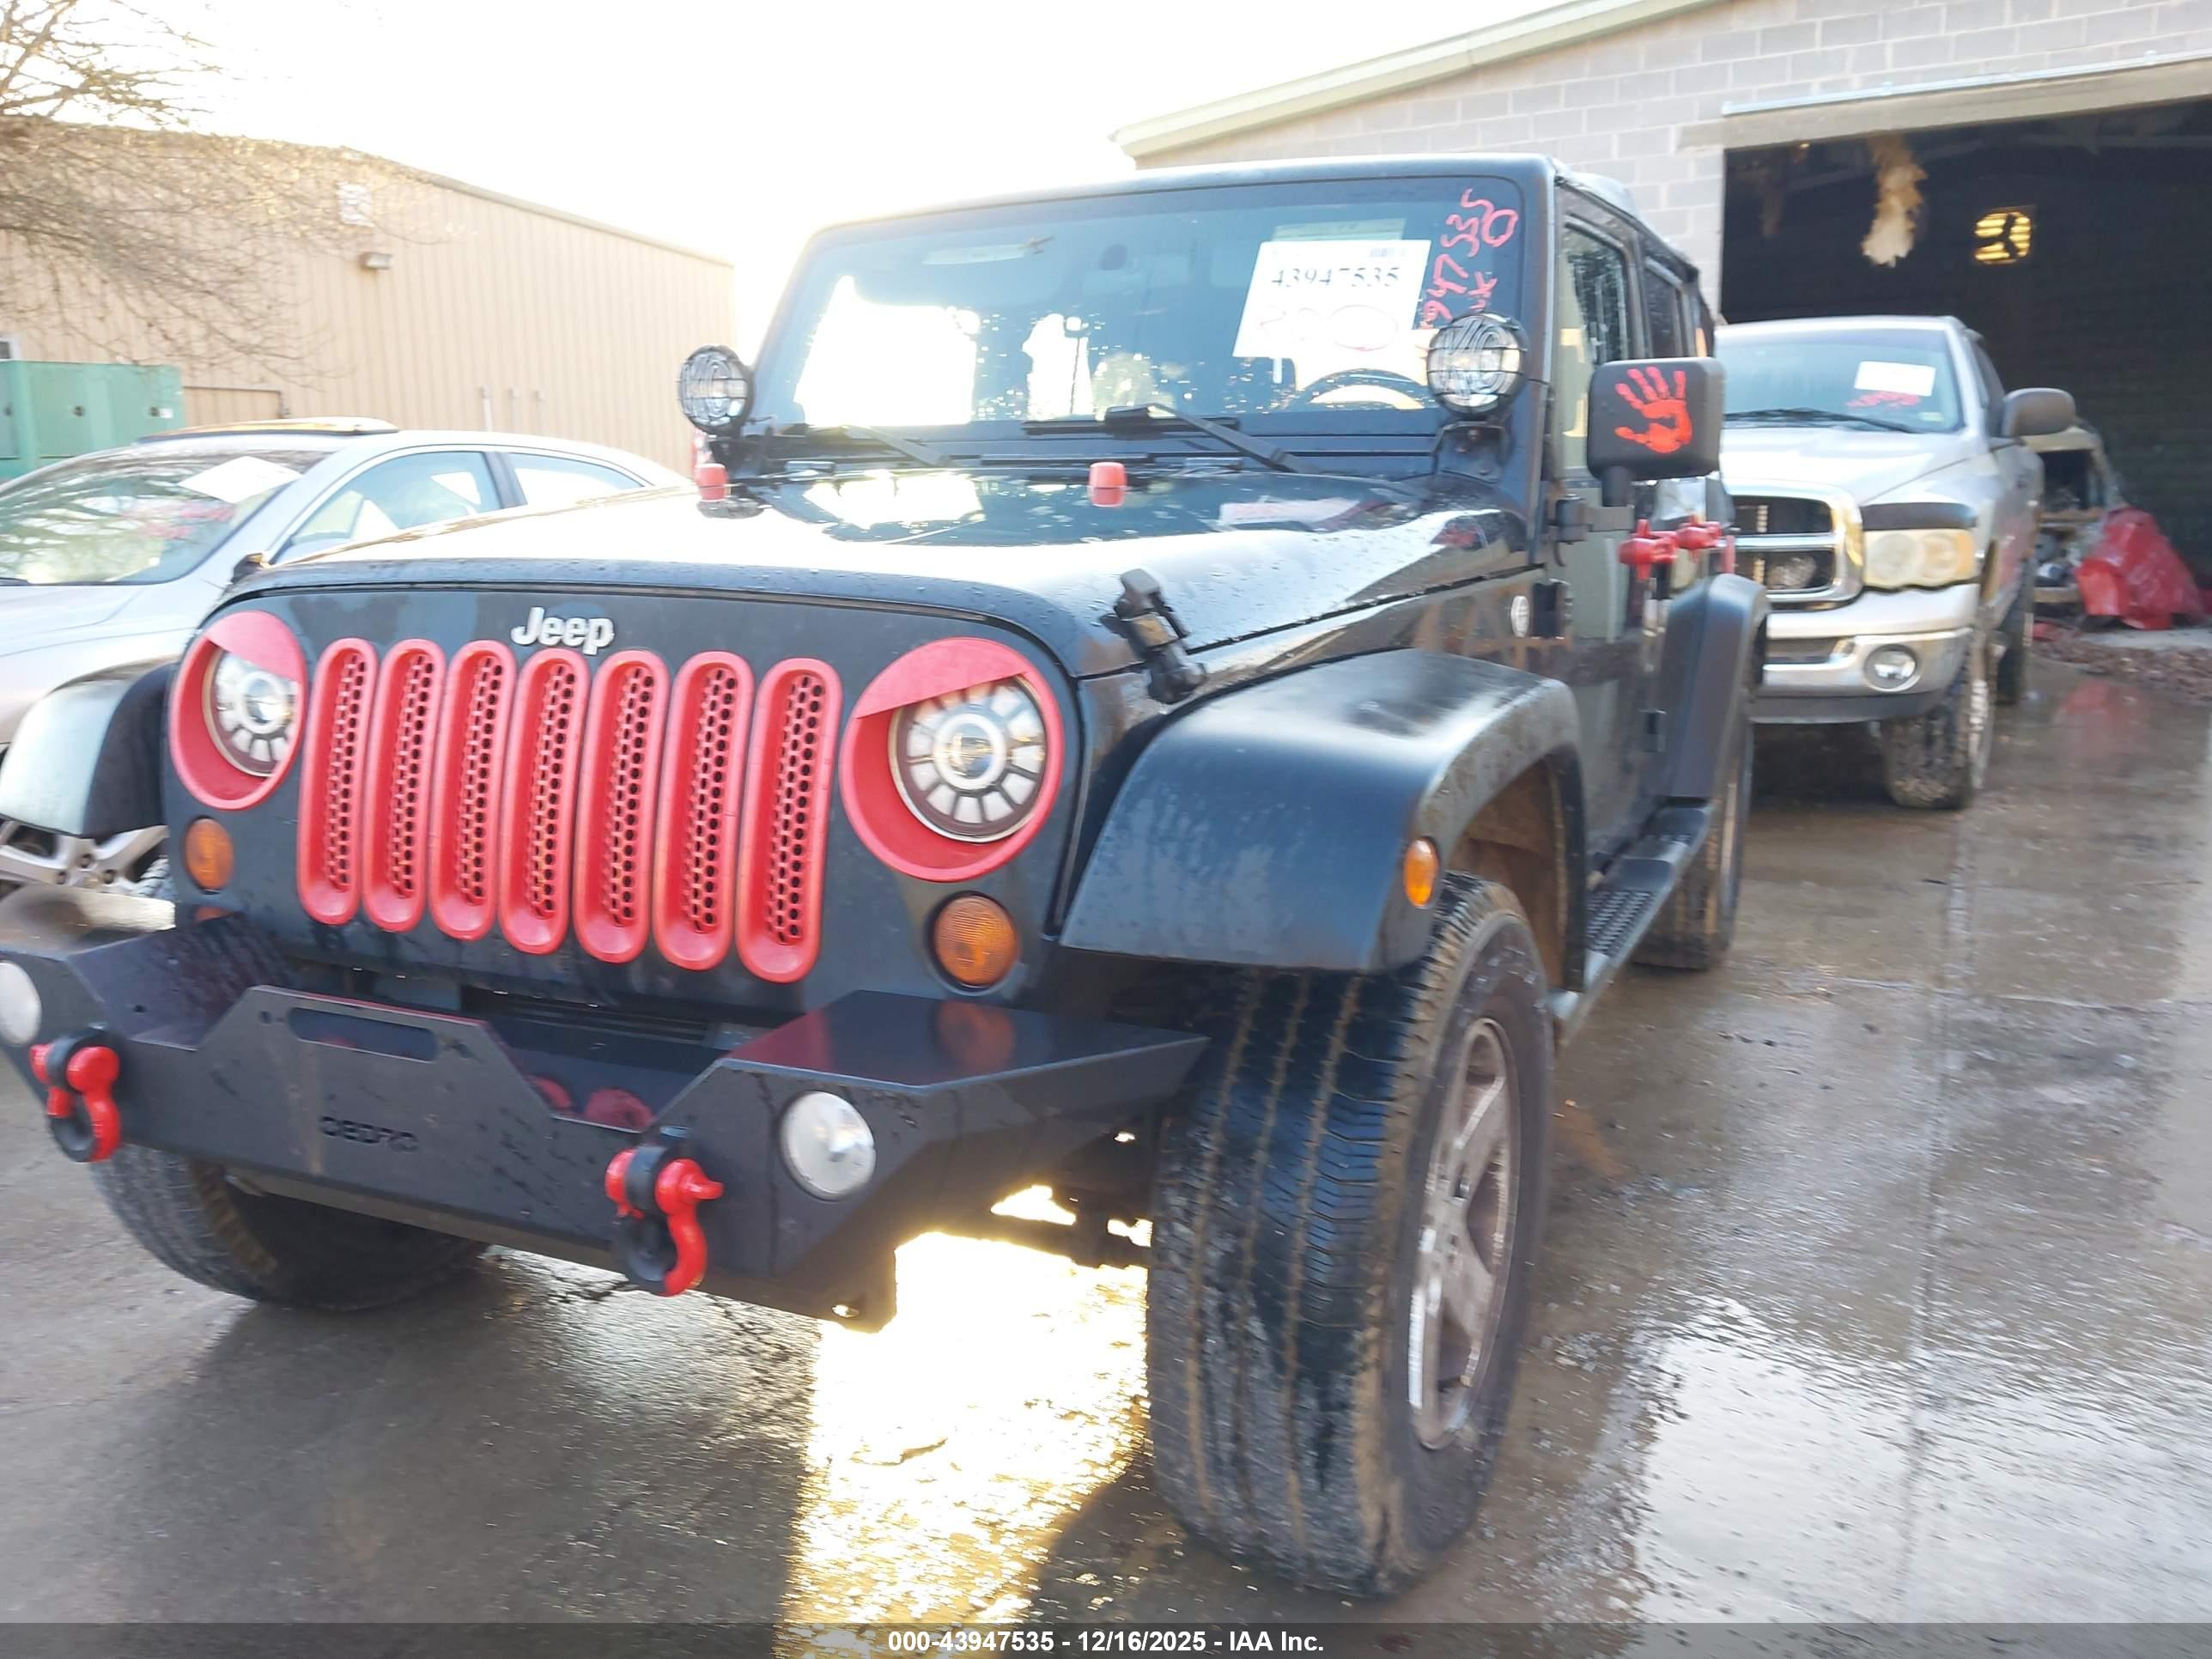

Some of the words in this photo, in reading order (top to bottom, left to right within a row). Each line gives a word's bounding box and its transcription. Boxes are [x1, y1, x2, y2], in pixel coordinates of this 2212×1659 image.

[1271, 267, 1400, 288] 43947535
[1419, 188, 1495, 330] 947535
[510, 606, 615, 656] Jeep
